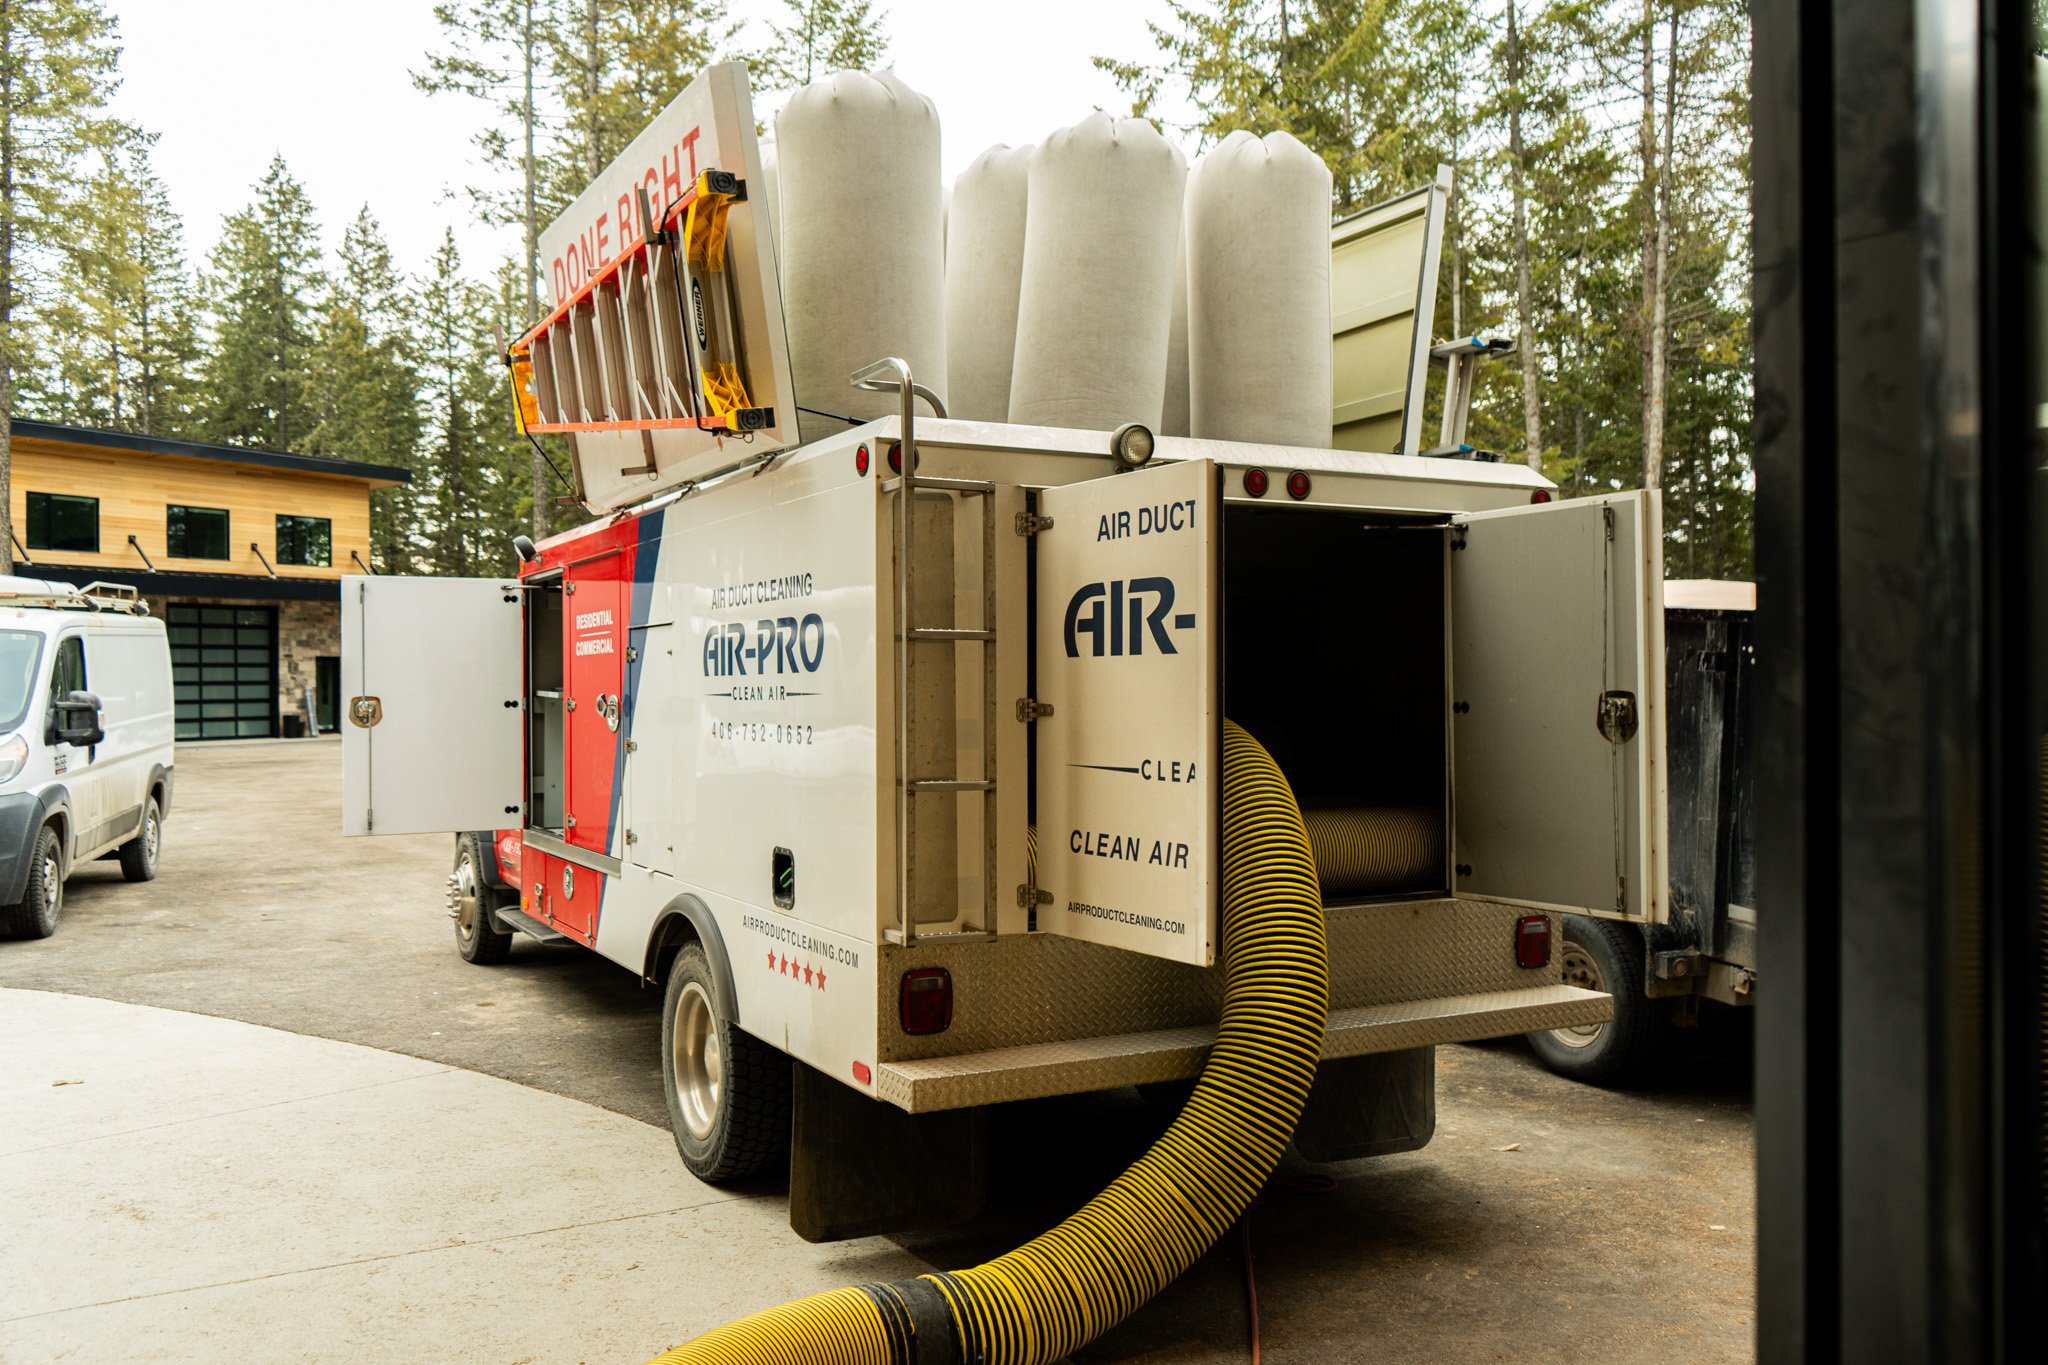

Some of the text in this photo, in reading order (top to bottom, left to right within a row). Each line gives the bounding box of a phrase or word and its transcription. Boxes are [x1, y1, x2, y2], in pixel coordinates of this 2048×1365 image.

[553, 125, 700, 306] DONE RIGHT
[694, 291, 706, 337] WERNER
[1097, 500, 1196, 542] AIR DUCT
[711, 572, 812, 610] AIR DUCT CLEANING
[576, 609, 613, 630] RESIDENTIAL
[1063, 576, 1196, 658] AIR-
[576, 637, 614, 657] COMMERCIAL
[703, 612, 825, 677] AIR-PRO
[732, 685, 786, 701] CLEAN AIR
[711, 721, 813, 745] 406-752-0652
[1070, 829, 1189, 869] CLEAN AIR
[1067, 901, 1186, 935] AIRPRODUCTCLEANING.COM
[742, 914, 859, 969] AIRPRODUCTCLEANING.COM
